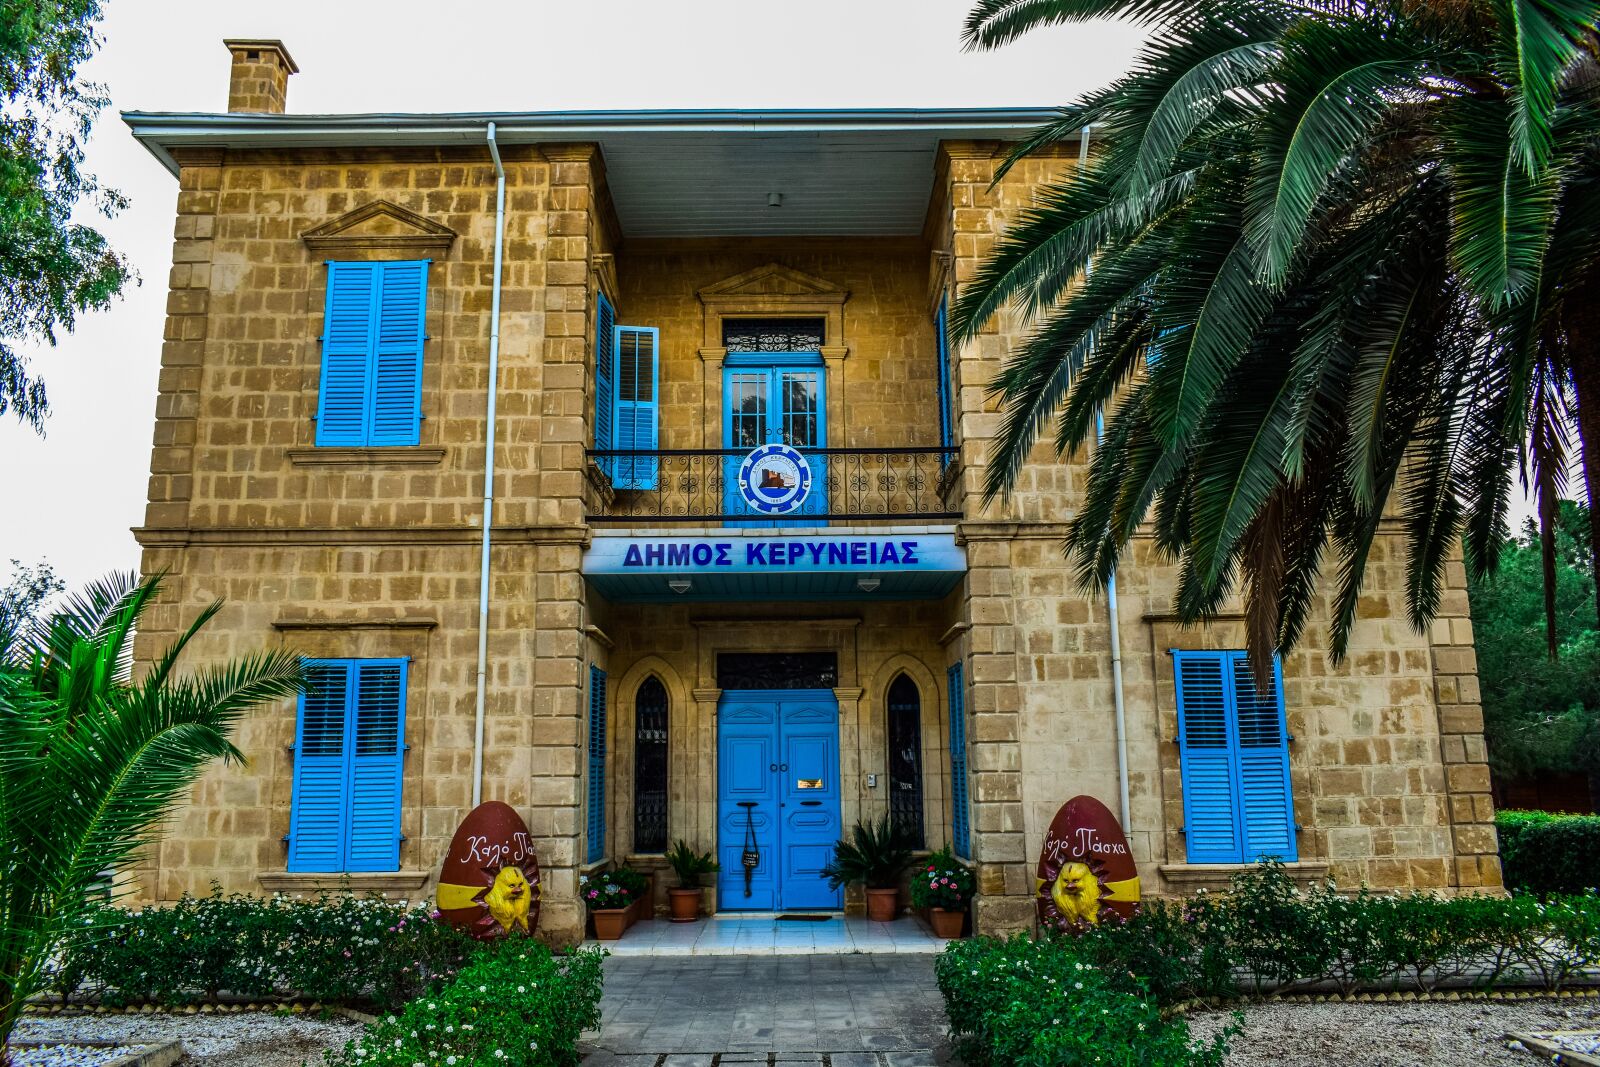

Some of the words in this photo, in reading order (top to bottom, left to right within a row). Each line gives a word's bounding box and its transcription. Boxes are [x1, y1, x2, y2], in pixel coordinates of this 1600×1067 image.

[623, 543, 732, 567] ΔΗΜΟΣ
[746, 541, 919, 565] ΚΕΡΥΝΕΙΑΣ
[460, 836, 510, 867] Καλό
[1072, 827, 1127, 857] Πάσχα
